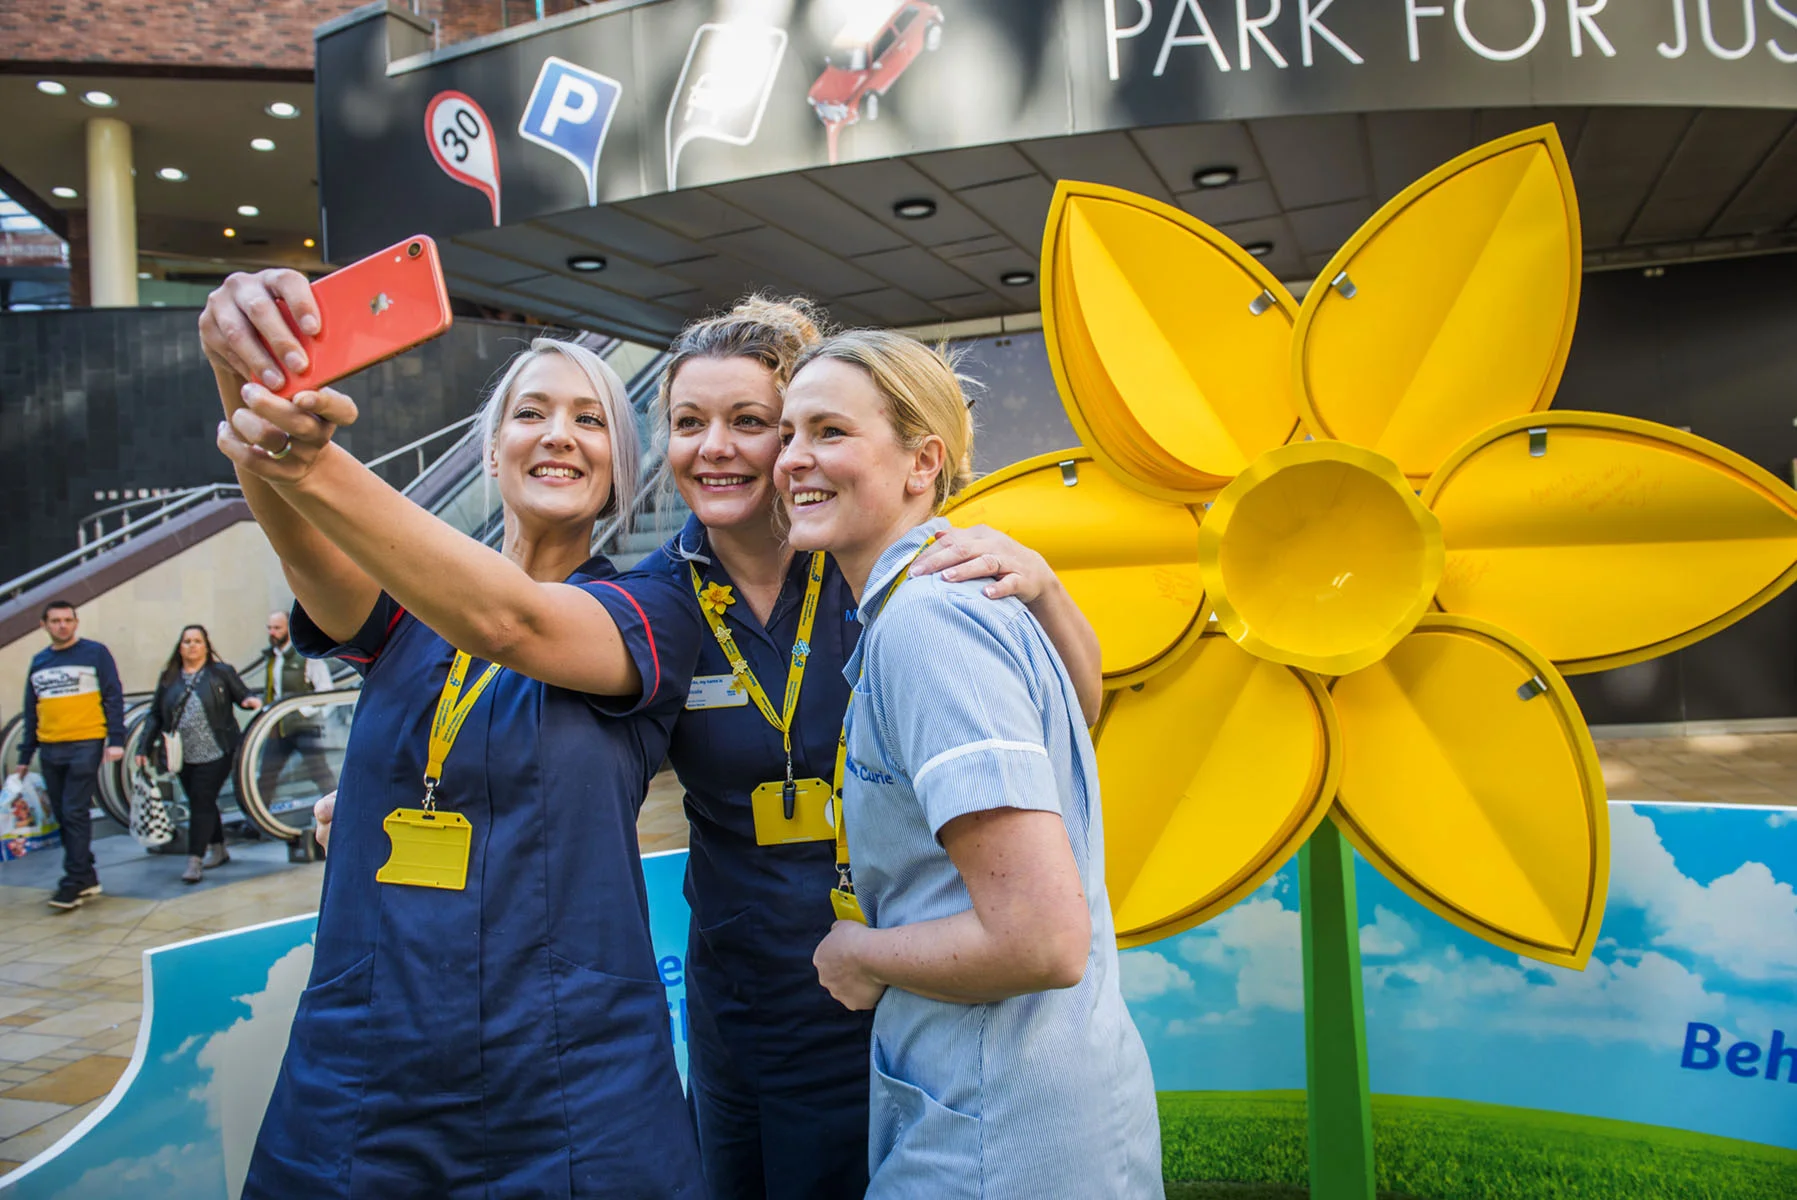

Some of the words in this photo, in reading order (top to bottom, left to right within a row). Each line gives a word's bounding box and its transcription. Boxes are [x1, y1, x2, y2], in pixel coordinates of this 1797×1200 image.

[1103, 0, 1365, 81] PARK
[1404, 0, 1617, 62] FOR
[442, 108, 481, 163] 30
[540, 73, 599, 137] P
[860, 765, 894, 785] Curie
[1680, 1021, 1797, 1085] Beh
